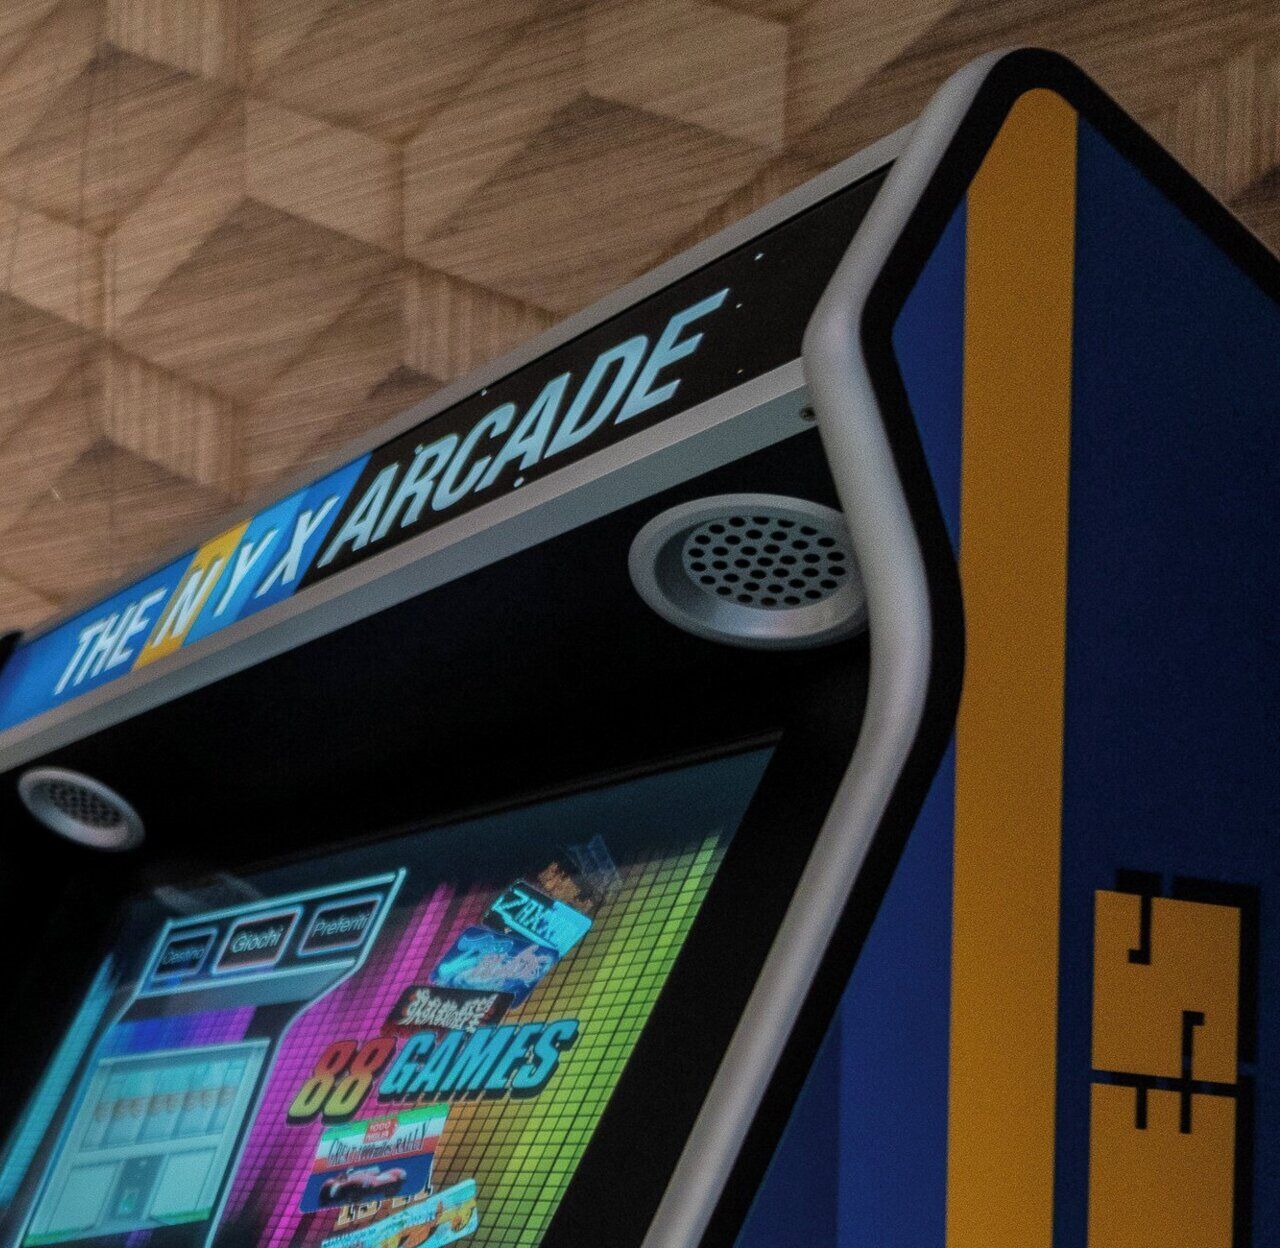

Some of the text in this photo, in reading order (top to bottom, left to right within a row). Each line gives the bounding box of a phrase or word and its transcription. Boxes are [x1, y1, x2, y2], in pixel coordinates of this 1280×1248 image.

[53, 286, 731, 694] THE NYX ARCADE
[231, 925, 284, 953] Giochi
[287, 1019, 579, 1123] 88 GAMES
